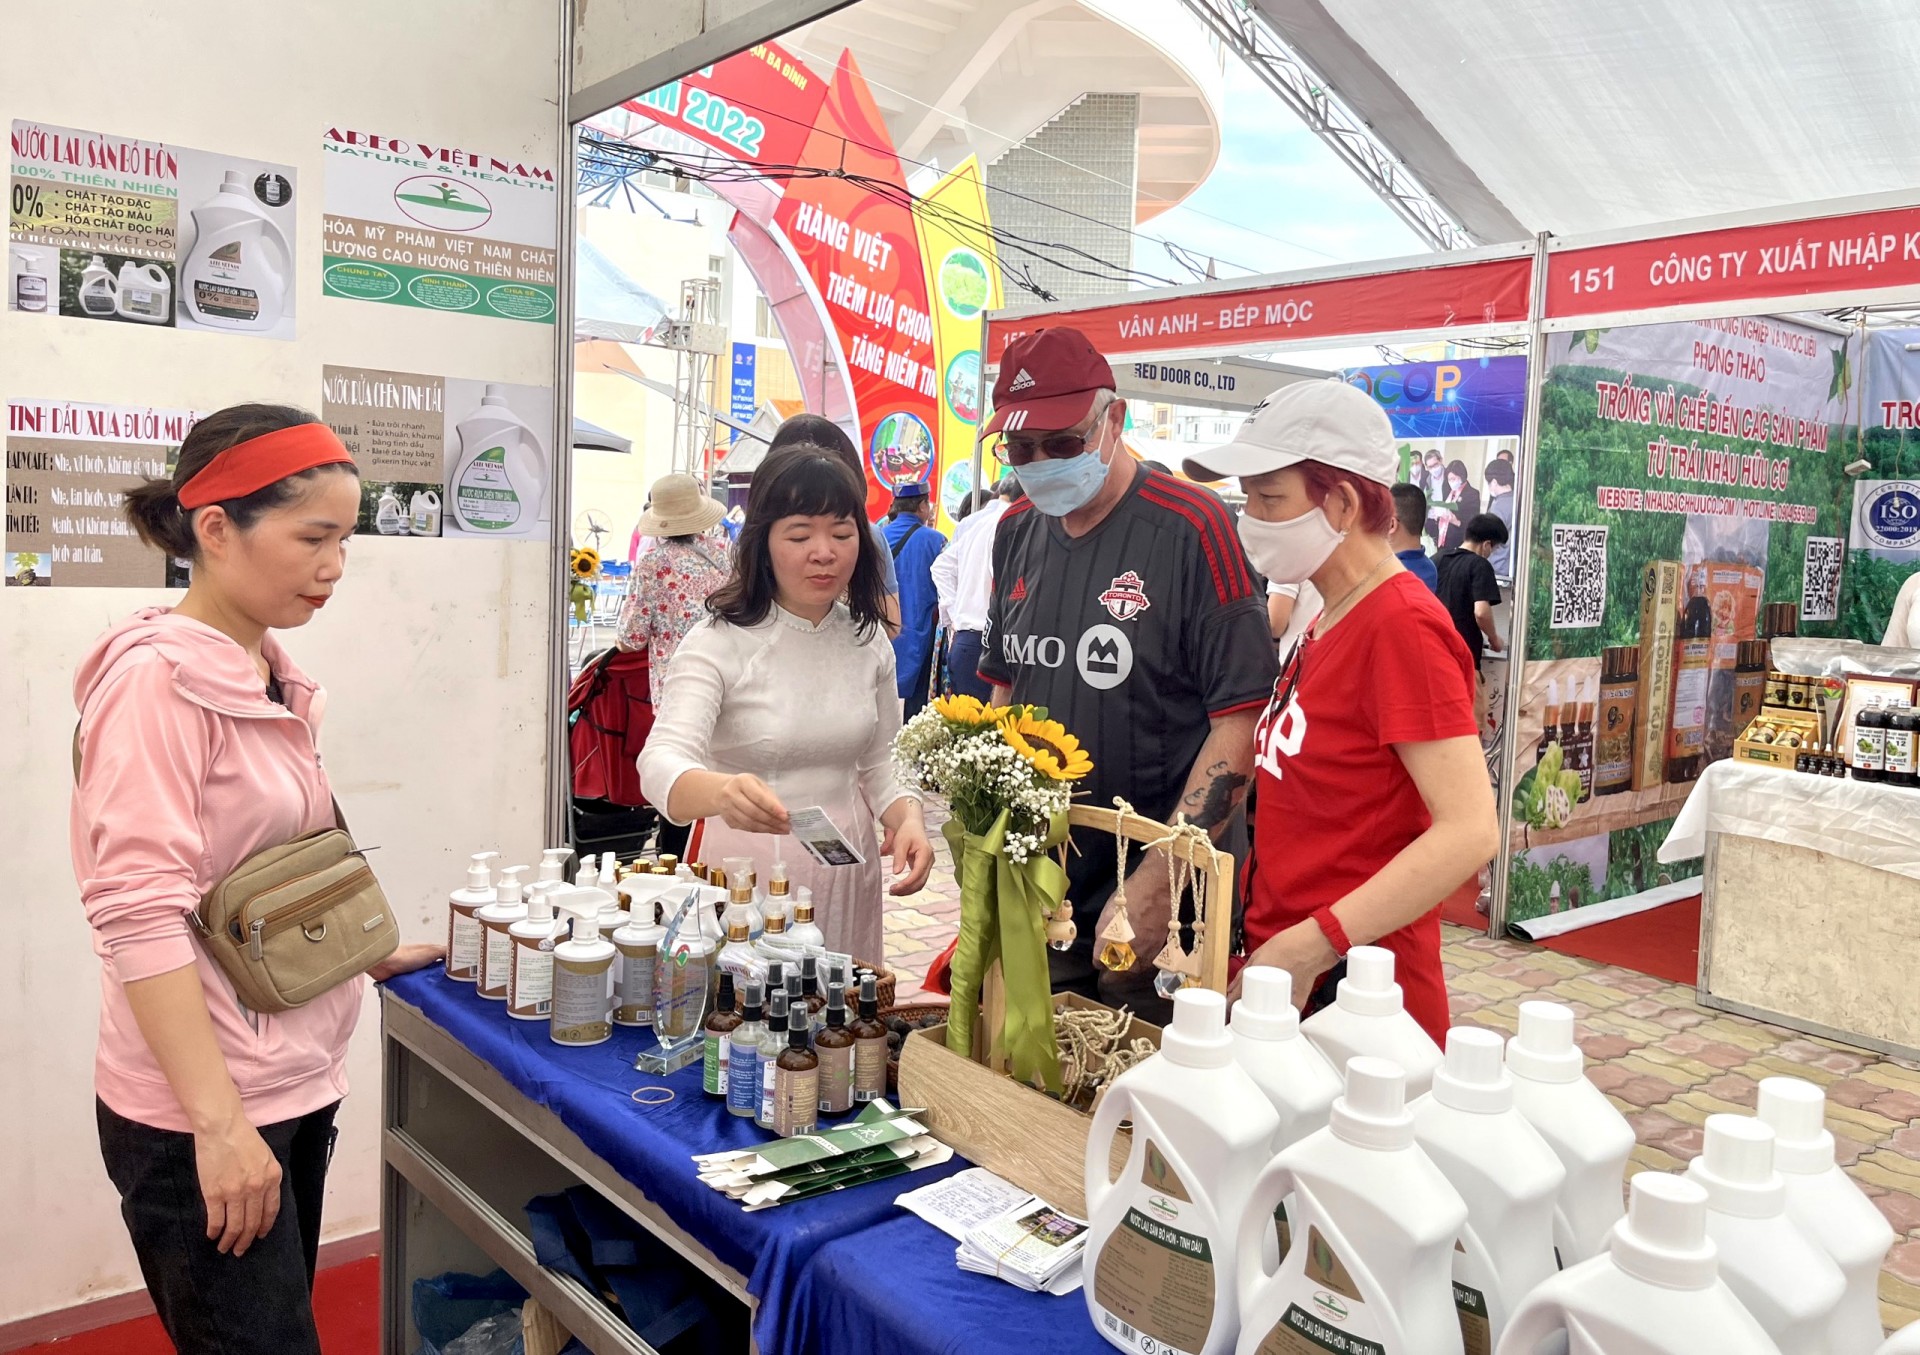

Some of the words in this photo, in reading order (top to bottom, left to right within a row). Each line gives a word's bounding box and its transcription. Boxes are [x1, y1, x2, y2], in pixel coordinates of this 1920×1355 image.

[766, 50, 781, 71] BA
[782, 63, 808, 91] ĐÌNH
[685, 89, 763, 155] 2022
[11, 125, 50, 161] NƯỚC
[54, 135, 85, 167] LAU
[88, 134, 117, 171] SÀN
[145, 143, 178, 180] HÒN
[322, 127, 410, 154] AREO
[417, 144, 483, 168] VIỆT
[490, 157, 554, 182] NAM
[323, 143, 427, 169] NATURE
[437, 165, 453, 173] &
[462, 170, 554, 192] HEALTH
[11, 164, 55, 179] 100%
[62, 171, 116, 188] THIÊN
[123, 181, 178, 197] NHIÊN
[13, 184, 44, 218] 0%
[101, 195, 124, 205] TẠO
[101, 207, 124, 218] TẠO
[10, 221, 34, 231] AN
[42, 225, 90, 238] TOÀN
[96, 232, 139, 245] TUYỆT
[66, 213, 90, 225] HÓA
[156, 226, 175, 238] HẠI
[324, 219, 355, 237] HÓA
[365, 226, 385, 240] MỸ
[445, 238, 474, 256] VIỆT
[484, 244, 511, 259] NAM
[521, 250, 555, 265] CHẤT
[796, 202, 849, 252] HÀNG
[854, 229, 892, 273] VIỆT
[324, 239, 377, 259] LƯỢNG
[382, 248, 413, 263] CAO
[418, 253, 469, 271] HƯỚNG
[474, 260, 511, 277] THIÊN
[517, 267, 554, 283] NHIÊN
[336, 266, 369, 276] CHUNG
[1569, 266, 1614, 294] 151
[1650, 252, 1712, 286] CÔNG
[1718, 251, 1747, 278] TY
[1757, 237, 1821, 275] XUẤT
[1828, 232, 1896, 271] NHẬP
[199, 291, 219, 302] 0%
[826, 271, 865, 314] THÊM
[867, 294, 895, 330] LỰA
[896, 304, 933, 346] CHỌN
[1119, 315, 1155, 339] VÂN
[1158, 313, 1198, 335] ANH
[1219, 303, 1259, 329] BẾP
[1265, 299, 1313, 328] MỘC
[849, 335, 884, 376] TĂNG
[886, 350, 919, 390] NIỀM
[921, 366, 936, 398] TIN
[1160, 366, 1191, 386] DOOR
[1217, 374, 1235, 391] LTD
[1694, 341, 1734, 376] PHONG
[1736, 345, 1766, 383] THẢO
[324, 374, 349, 405] NƯỚC
[352, 374, 372, 407] RỬA
[374, 377, 400, 408] CHÉN
[401, 385, 425, 410] TINH
[1010, 380, 1036, 392] adidas
[8, 404, 47, 433] TINH
[52, 403, 82, 440] DẦU
[87, 410, 120, 437] XUA
[124, 408, 159, 440] ĐUỔI
[163, 411, 201, 442] MUỖ
[1597, 376, 1650, 423] TRỒNG
[1655, 384, 1675, 427] VÀ
[1678, 389, 1707, 432] CHẾ
[1709, 394, 1739, 437] BIẾN
[1648, 435, 1667, 478] TỪ
[1670, 441, 1700, 482] TRÁI
[1702, 445, 1738, 486] NHÀU
[1770, 457, 1789, 491] CƠ
[1876, 525, 1919, 533] 22000:2018
[1880, 505, 1917, 519] ISO
[1874, 535, 1917, 546] COMPANY
[1108, 592, 1142, 601] TORONTO
[1003, 634, 1065, 668] BMO
